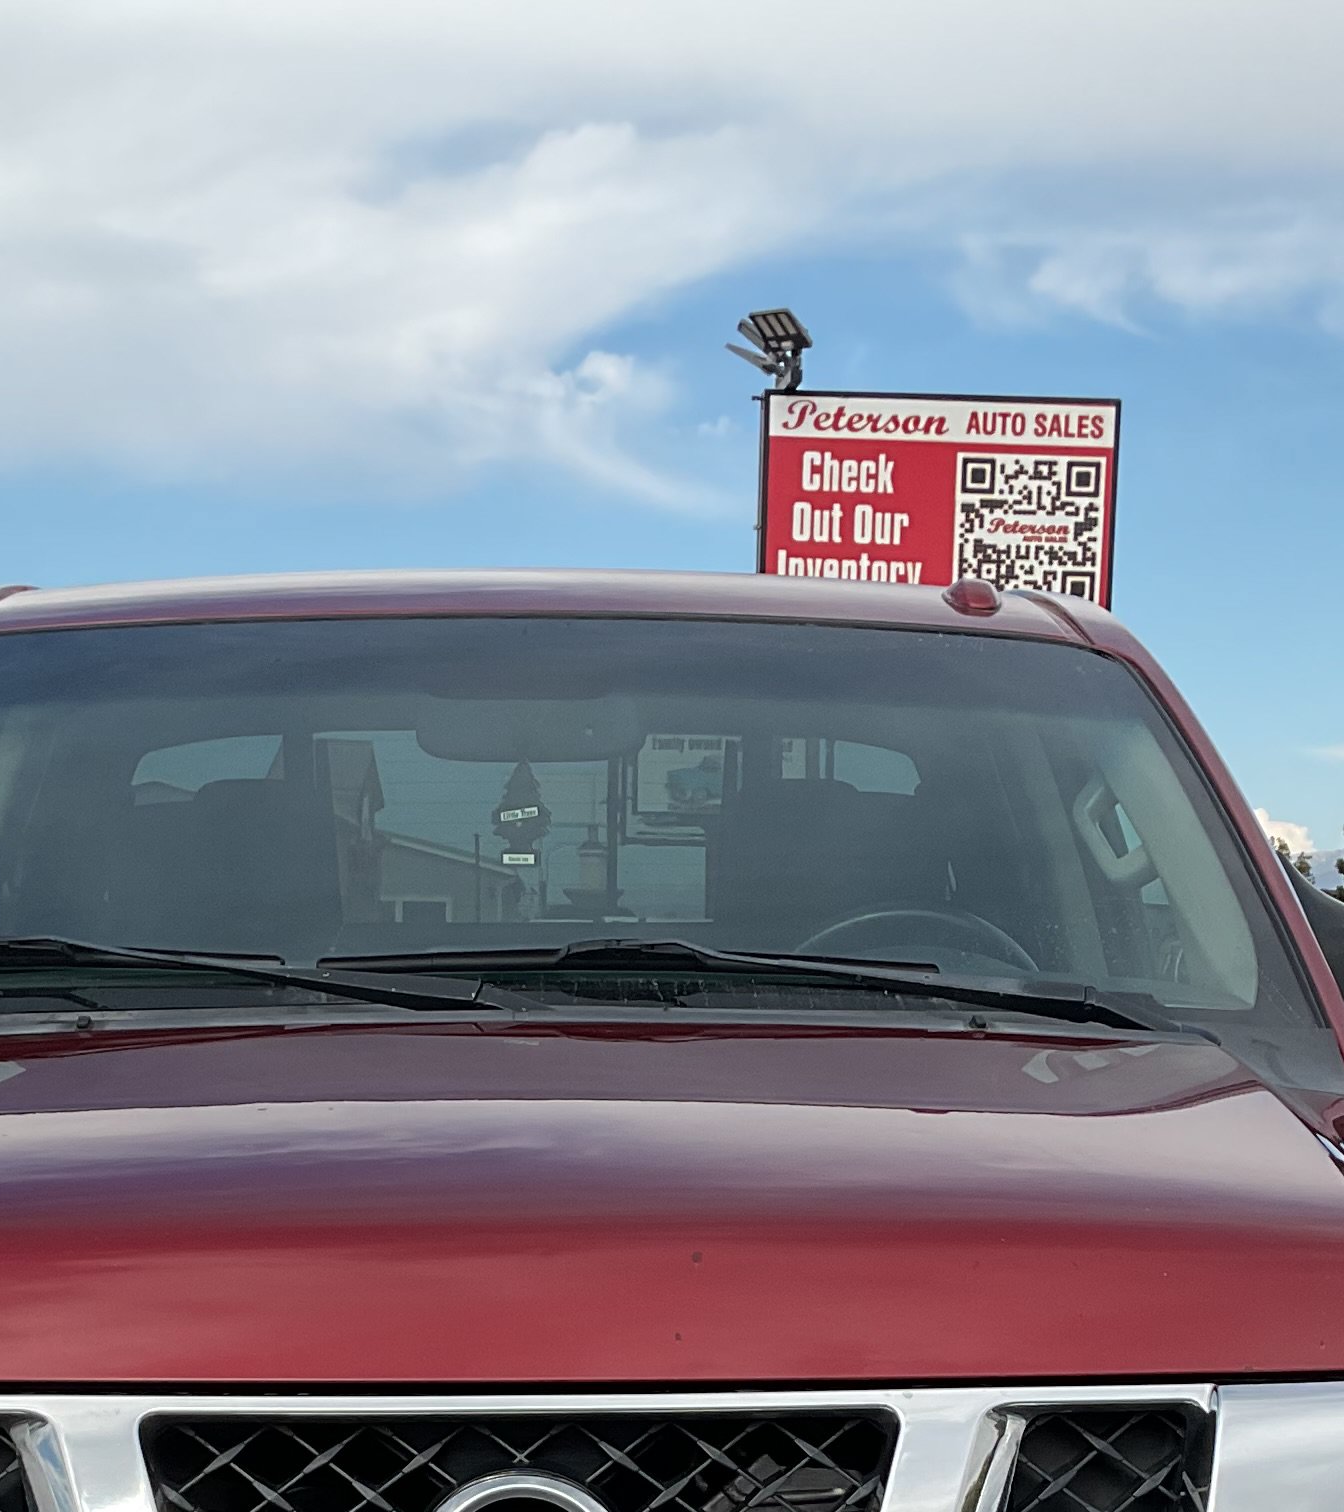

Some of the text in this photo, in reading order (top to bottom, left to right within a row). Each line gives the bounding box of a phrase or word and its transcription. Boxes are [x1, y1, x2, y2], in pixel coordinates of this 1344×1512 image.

[782, 399, 1104, 439] Peterson AUTO SALES
[802, 450, 895, 494] Check
[792, 501, 910, 545] Out Our
[987, 517, 1070, 535] Peterson
